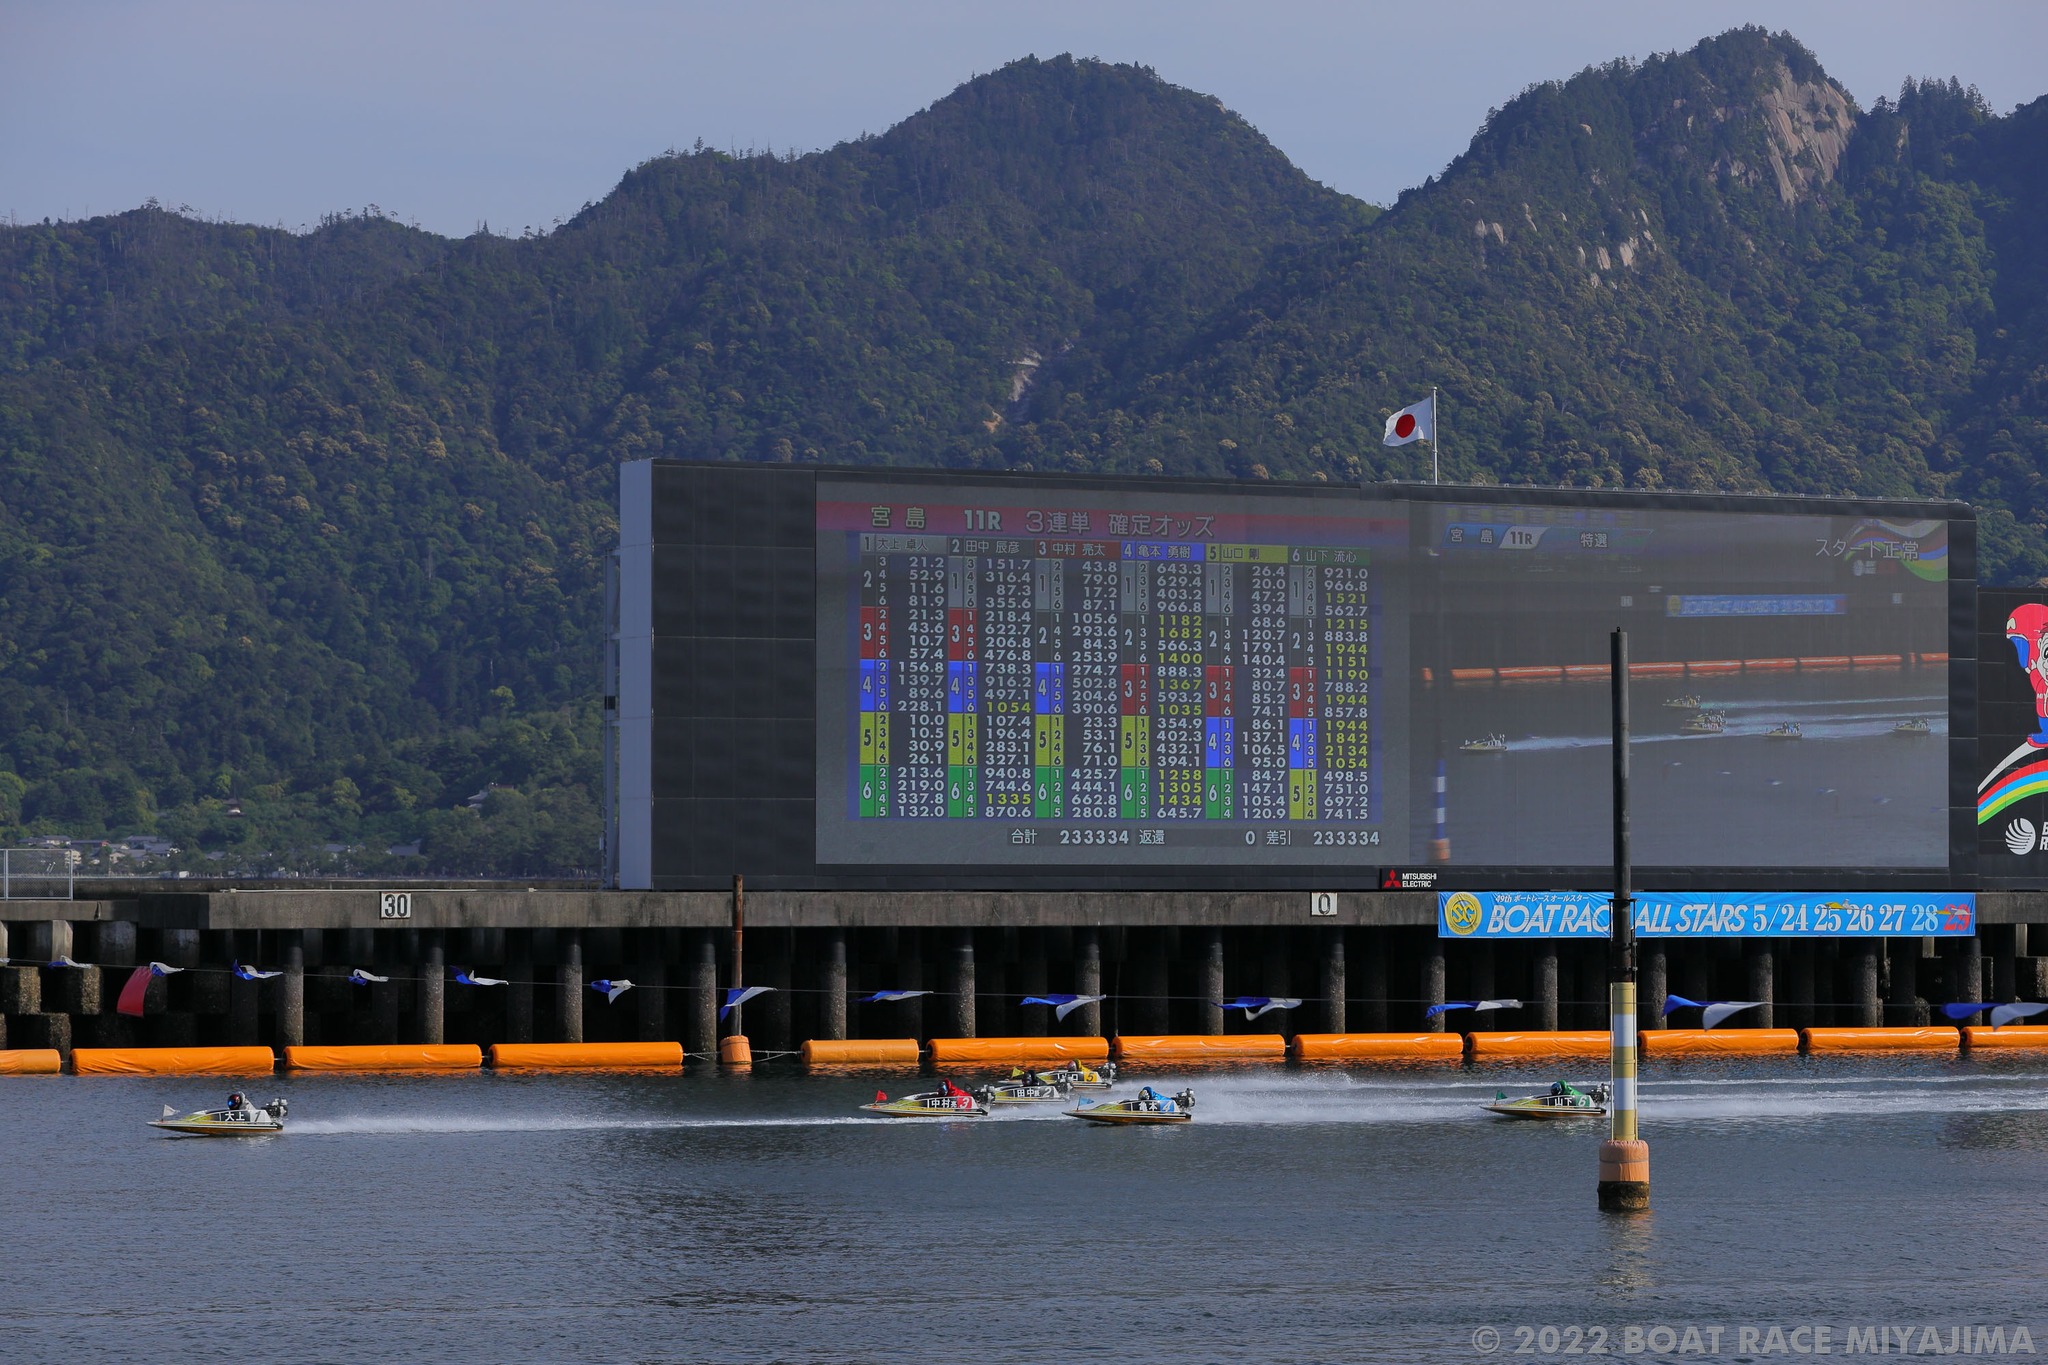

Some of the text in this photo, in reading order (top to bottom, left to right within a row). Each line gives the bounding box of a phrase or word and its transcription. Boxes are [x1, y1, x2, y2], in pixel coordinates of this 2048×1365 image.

[965, 510, 1002, 530] 11R
[1026, 510, 1090, 534] 3連単
[1109, 513, 1215, 538] 確定オッズ
[1510, 531, 1533, 545] 11R
[1580, 532, 1608, 548] 特選
[864, 537, 870, 552] 1
[952, 539, 960, 553] 2
[1039, 542, 1047, 555] 3
[1124, 544, 1132, 557] 4
[1209, 546, 1217, 560] 5
[1292, 549, 1300, 562] 6
[1815, 538, 1919, 561] スタート正常
[909, 557, 1369, 579] 21.2 151.7 43.8 643.3 26.4 921.0
[909, 570, 1368, 591] 52.9 316.4 79.0 629.4 20.0 966.8
[908, 595, 1368, 616] 81.9 355.6 87.1 966.8 39.4 562.7
[909, 609, 1368, 629] 21.3 218.4 105.6 1182 68.6 1215
[910, 635, 1368, 654] 10.7 206.8 84.3 566.3 179.1 1944
[909, 648, 1366, 666] 57.4 476.8 253.9 1400 140.4 1151
[899, 675, 1368, 692] 139.7 916.2 502.8 1367 80.7 788.2
[908, 688, 1368, 705] 89.6 497.1 204.6 593.2 85.2 1944
[910, 715, 1368, 730] 10.0 107.4 23.3 354.9 86.1 1944
[910, 728, 1368, 743] 10.5 196.4 53.1 402.3 137.1 1842
[909, 754, 1368, 768] 26.1 327.1 71.0 394.1 95.0 1054
[897, 767, 1368, 781] 213.6 940.8 425.7 1258 84.7 498.5
[897, 793, 1368, 806] 337.8 1335 662.8 1434 105.4 697.2
[898, 806, 1368, 819] 132.0 870.6 280.8 645.7 120.9 741.5
[1011, 829, 1380, 846] 合計 233334 返還 0 差引 233334
[1402, 880, 1431, 888] ELECTRIC
[384, 894, 408, 917] 30
[1318, 893, 1331, 915] 0
[1495, 895, 1511, 903] 49th
[1559, 903, 1624, 933] RAC
[1634, 903, 1672, 932] ALL
[1675, 903, 1749, 932] STARS
[1752, 903, 1809, 932] 5/24
[1813, 904, 1842, 932] 25
[1846, 904, 1875, 932] 26
[1878, 904, 1907, 932] 27
[1911, 904, 1939, 932] 28
[1942, 904, 1971, 932] 29
[1086, 1072, 1094, 1082] 5
[1042, 1087, 1052, 1098] 2
[960, 1097, 969, 1109] 3
[1163, 1101, 1173, 1111] 4
[1554, 1096, 1587, 1107] 山下 6
[225, 1110, 245, 1121] 大上
